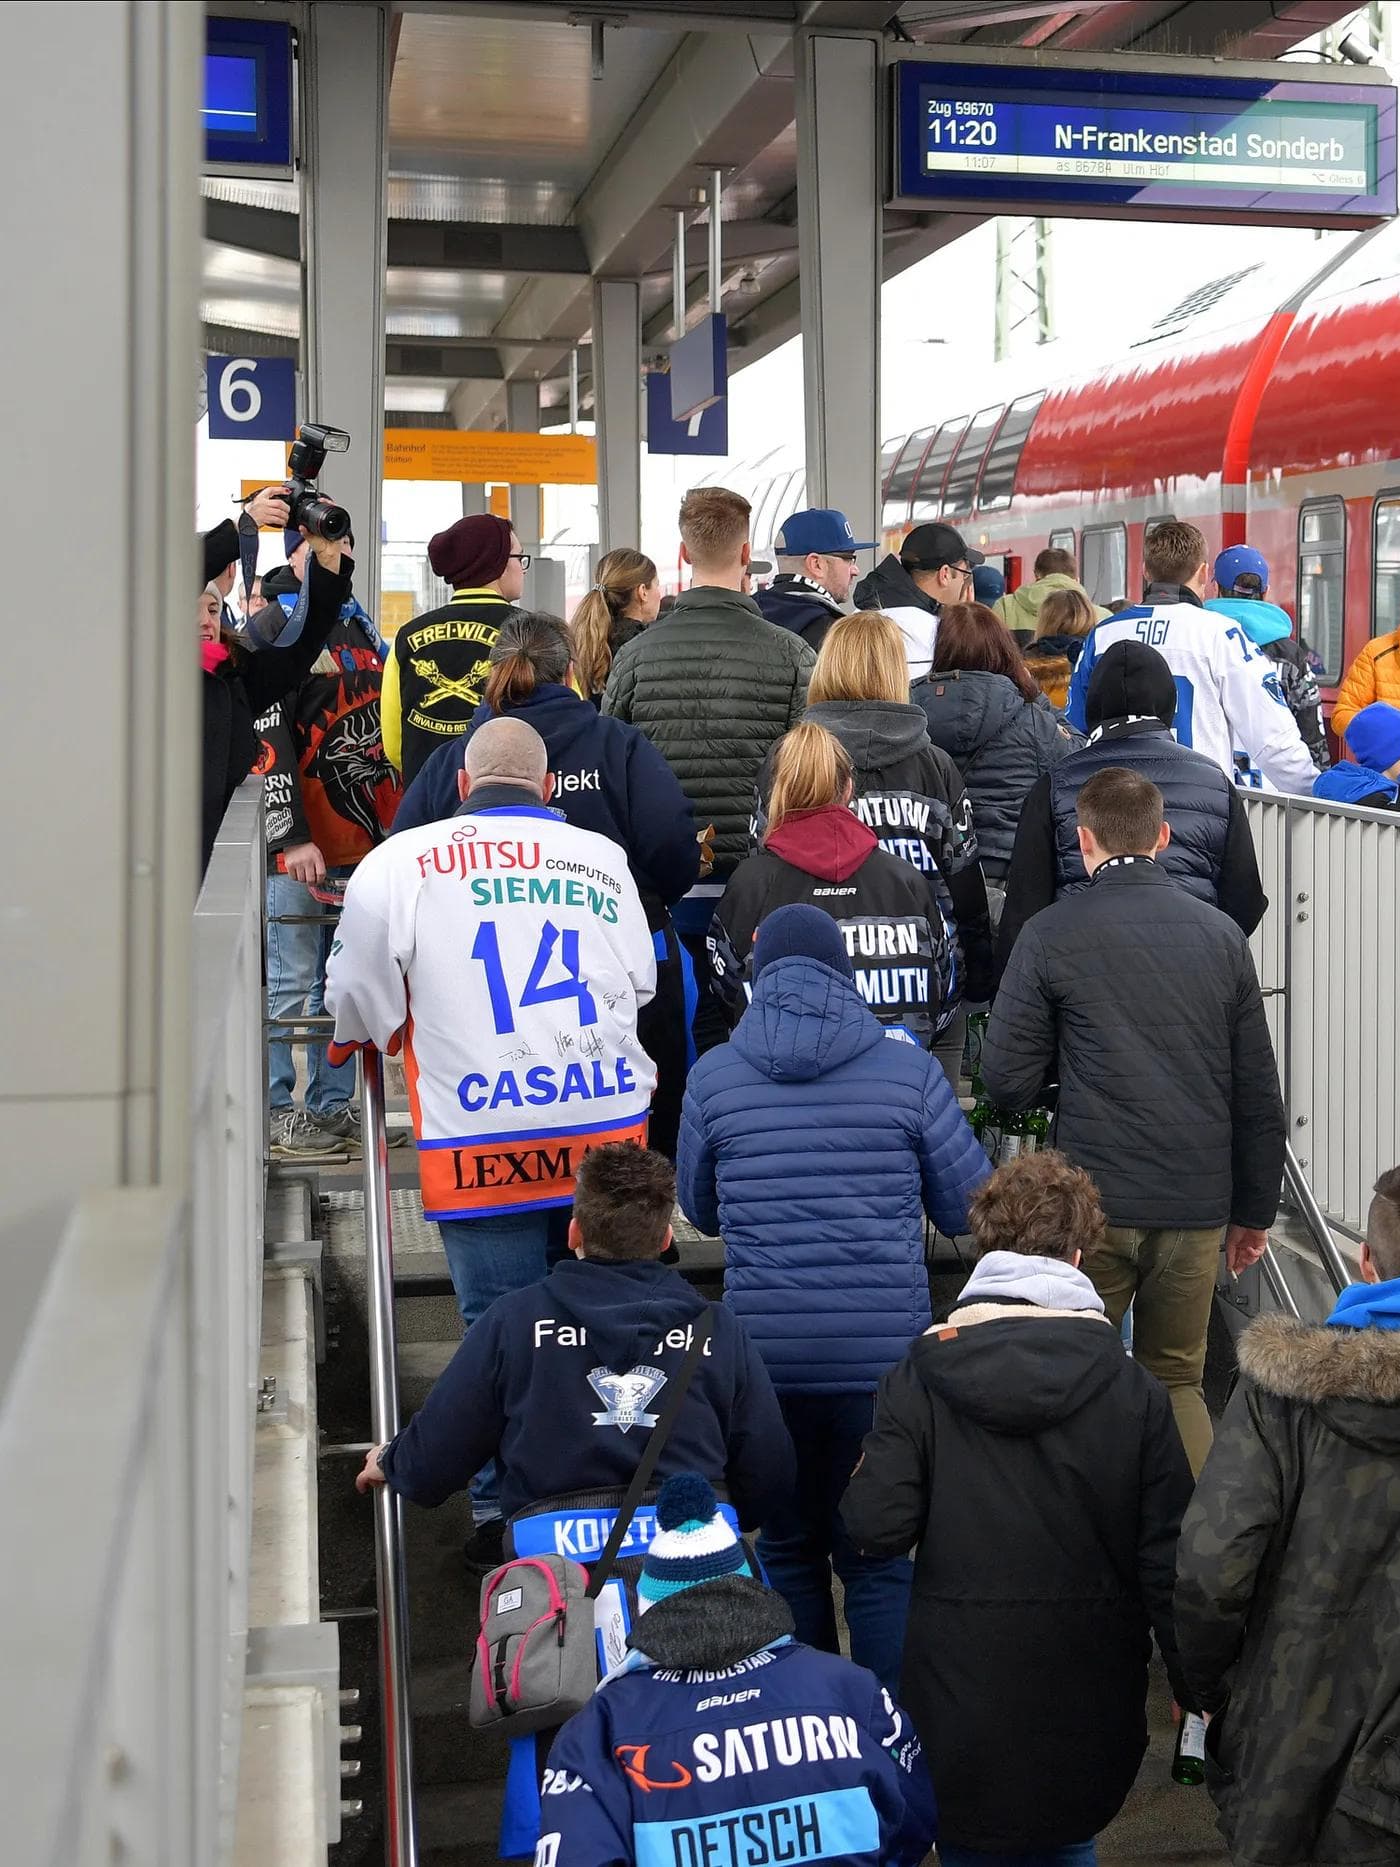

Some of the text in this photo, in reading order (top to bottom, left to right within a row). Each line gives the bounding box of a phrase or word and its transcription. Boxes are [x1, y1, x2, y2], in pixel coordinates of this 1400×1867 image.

[927, 100, 994, 117] Zug 59670
[927, 118, 1344, 162] 11:20 N-Frankenstad Sonderb
[964, 156, 996, 169] 11:07
[219, 358, 261, 421] 6
[386, 443, 426, 452] Bahnhof
[1136, 620, 1170, 645] SIGI
[413, 714, 446, 731] RIVALEN
[446, 724, 454, 732] &
[552, 769, 601, 798] jekt
[849, 797, 930, 834] ATURN
[416, 840, 623, 895] FUJITSU COMPUTERS
[470, 876, 620, 924] SIEMENS
[812, 887, 857, 897] BAUER
[843, 923, 919, 958] TURN
[470, 919, 599, 1036] 14
[457, 1057, 637, 1112] CASALE
[695, 1688, 762, 1712] BAUER
[692, 1714, 863, 1784] SATURN
[671, 1802, 822, 1867] DETSCH
